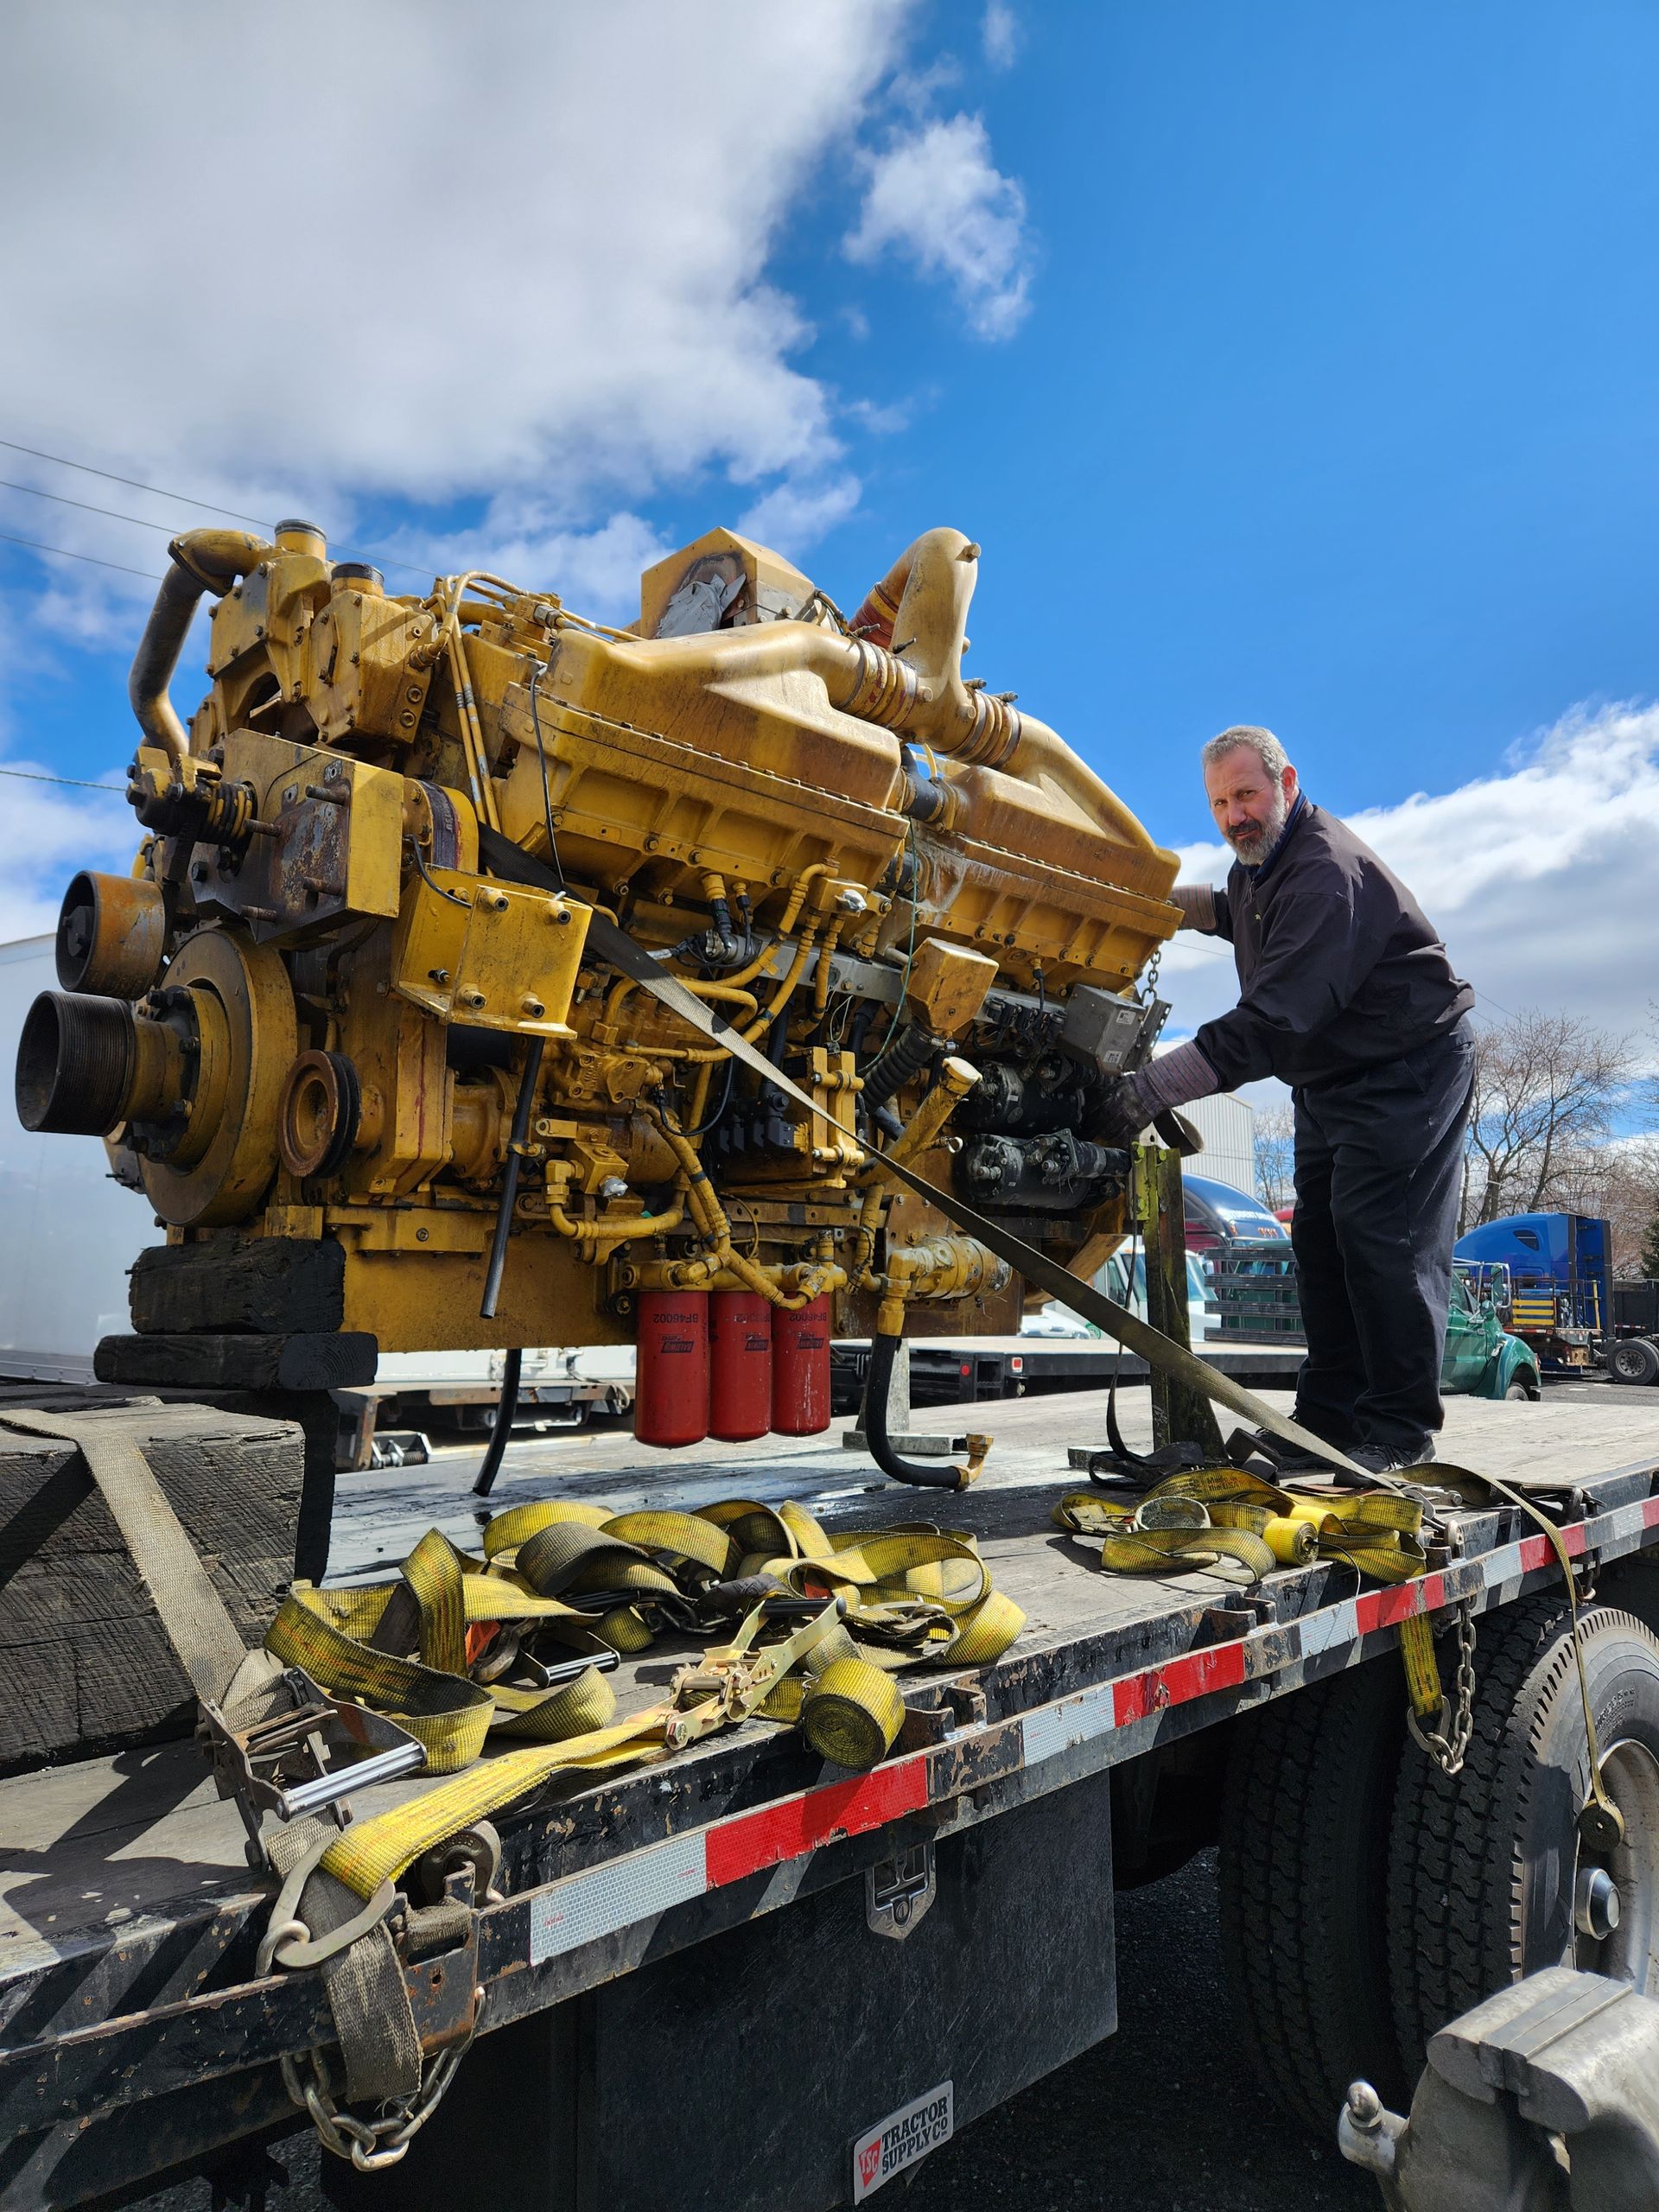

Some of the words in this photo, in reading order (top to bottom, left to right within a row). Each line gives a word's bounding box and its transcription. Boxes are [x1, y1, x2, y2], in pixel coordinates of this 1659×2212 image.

[653, 1313, 698, 1323] BF46002
[881, 2096, 948, 2152] TRACTOR
[860, 2149, 879, 2174] TSC
[881, 2126, 932, 2176] SUPPLY
